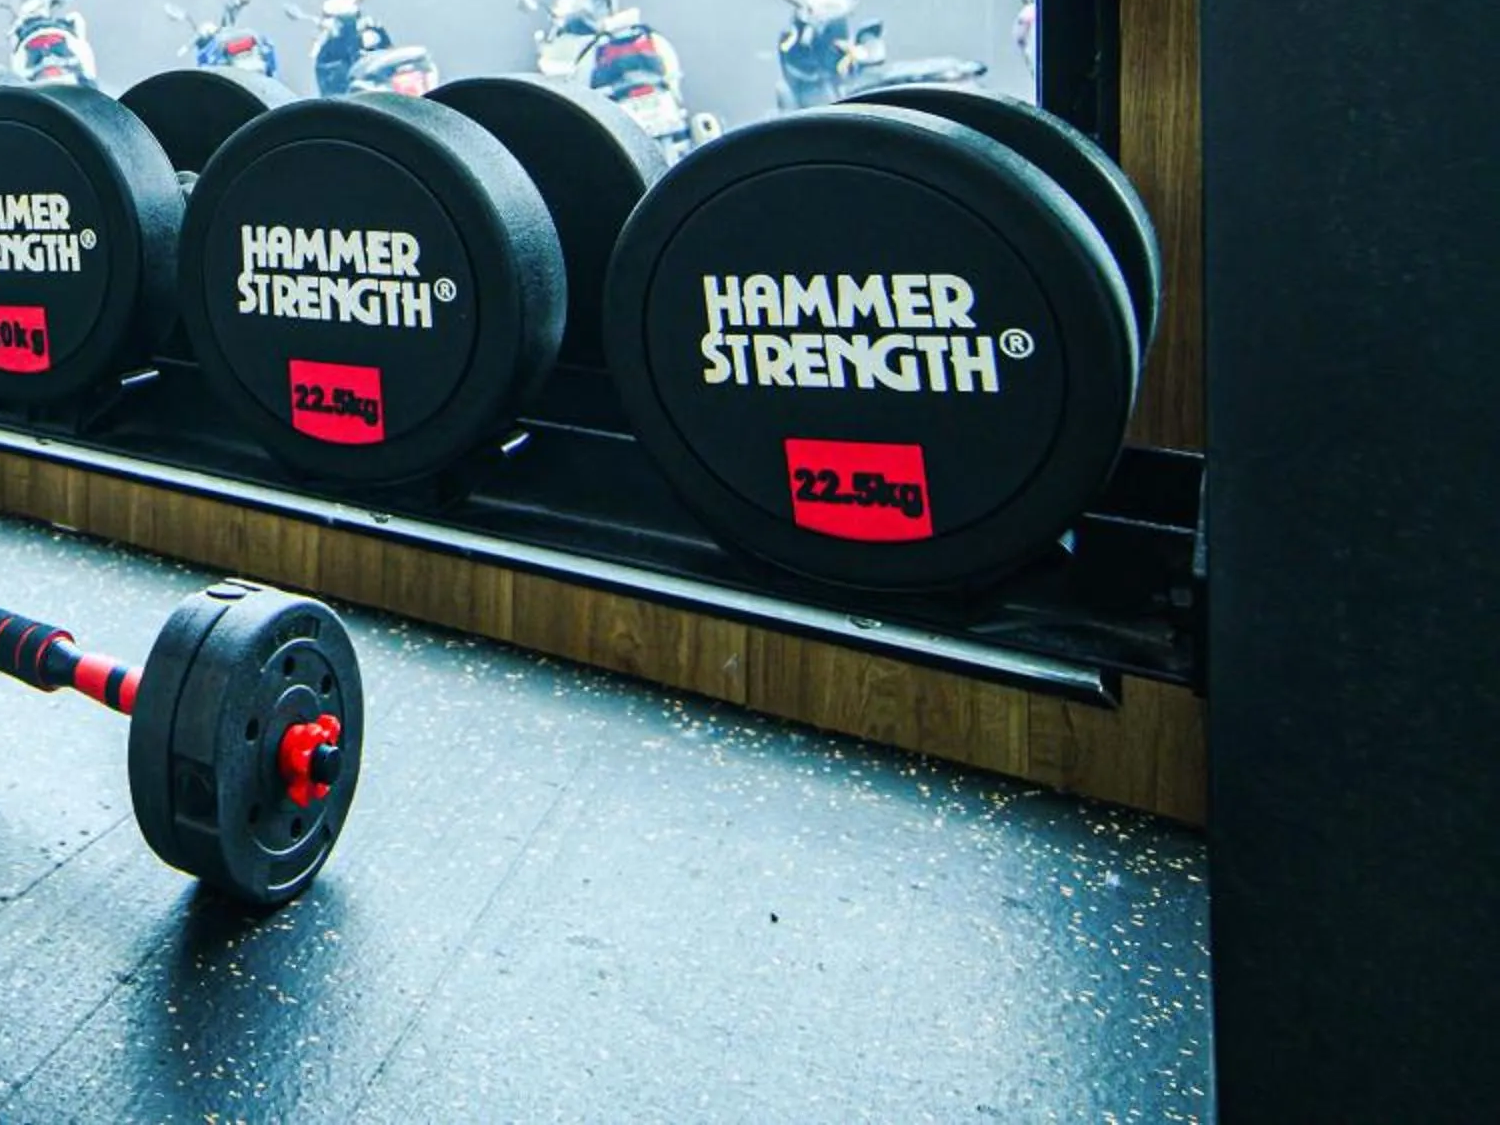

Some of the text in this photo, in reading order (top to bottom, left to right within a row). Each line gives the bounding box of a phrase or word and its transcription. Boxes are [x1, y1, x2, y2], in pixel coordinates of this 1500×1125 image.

[241, 224, 421, 277] HAMMER
[237, 271, 457, 328] STRENGTH®
[703, 274, 977, 329] HAMMER
[701, 328, 1035, 393] STRENGTH®
[294, 384, 380, 426] 22.5kg
[793, 467, 925, 519] 22.5kg
